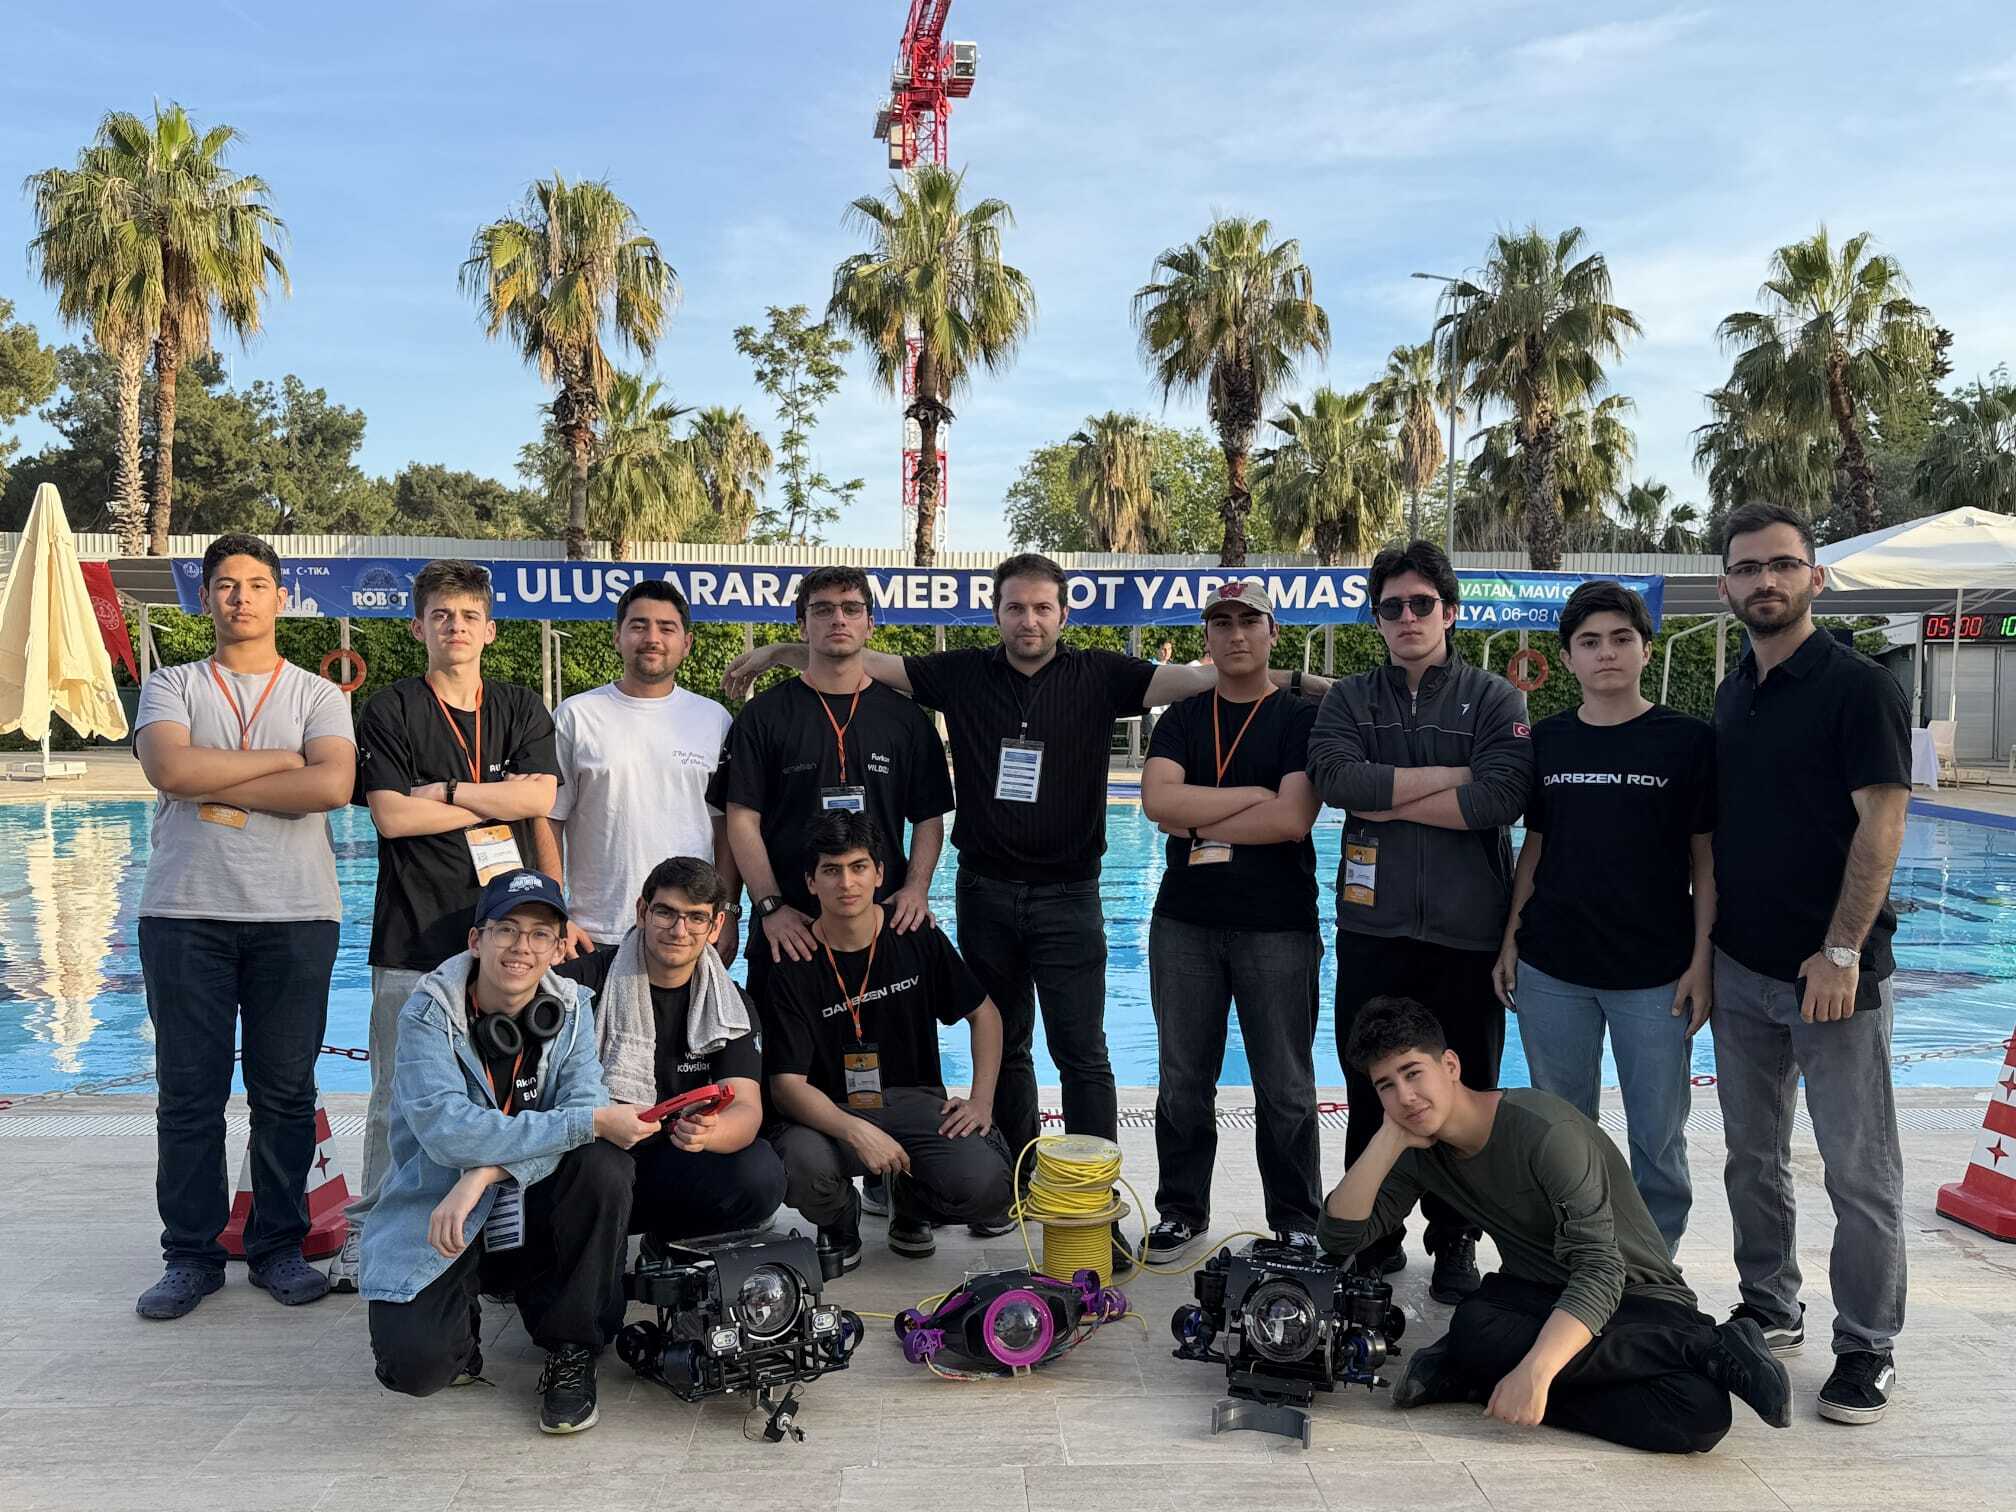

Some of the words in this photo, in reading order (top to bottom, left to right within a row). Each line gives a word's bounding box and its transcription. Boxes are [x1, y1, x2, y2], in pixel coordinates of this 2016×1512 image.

[352, 591, 409, 607] ROBOT
[865, 575, 959, 610] MEB
[970, 575, 1125, 610] ROT
[1519, 583, 1560, 599] MAVİ
[1501, 607, 1548, 622] 06-08
[1926, 616, 1984, 637] 05:00
[1543, 773, 1622, 786] DARBZEN
[1626, 774, 1669, 788] ROV
[890, 975, 919, 994] ROV
